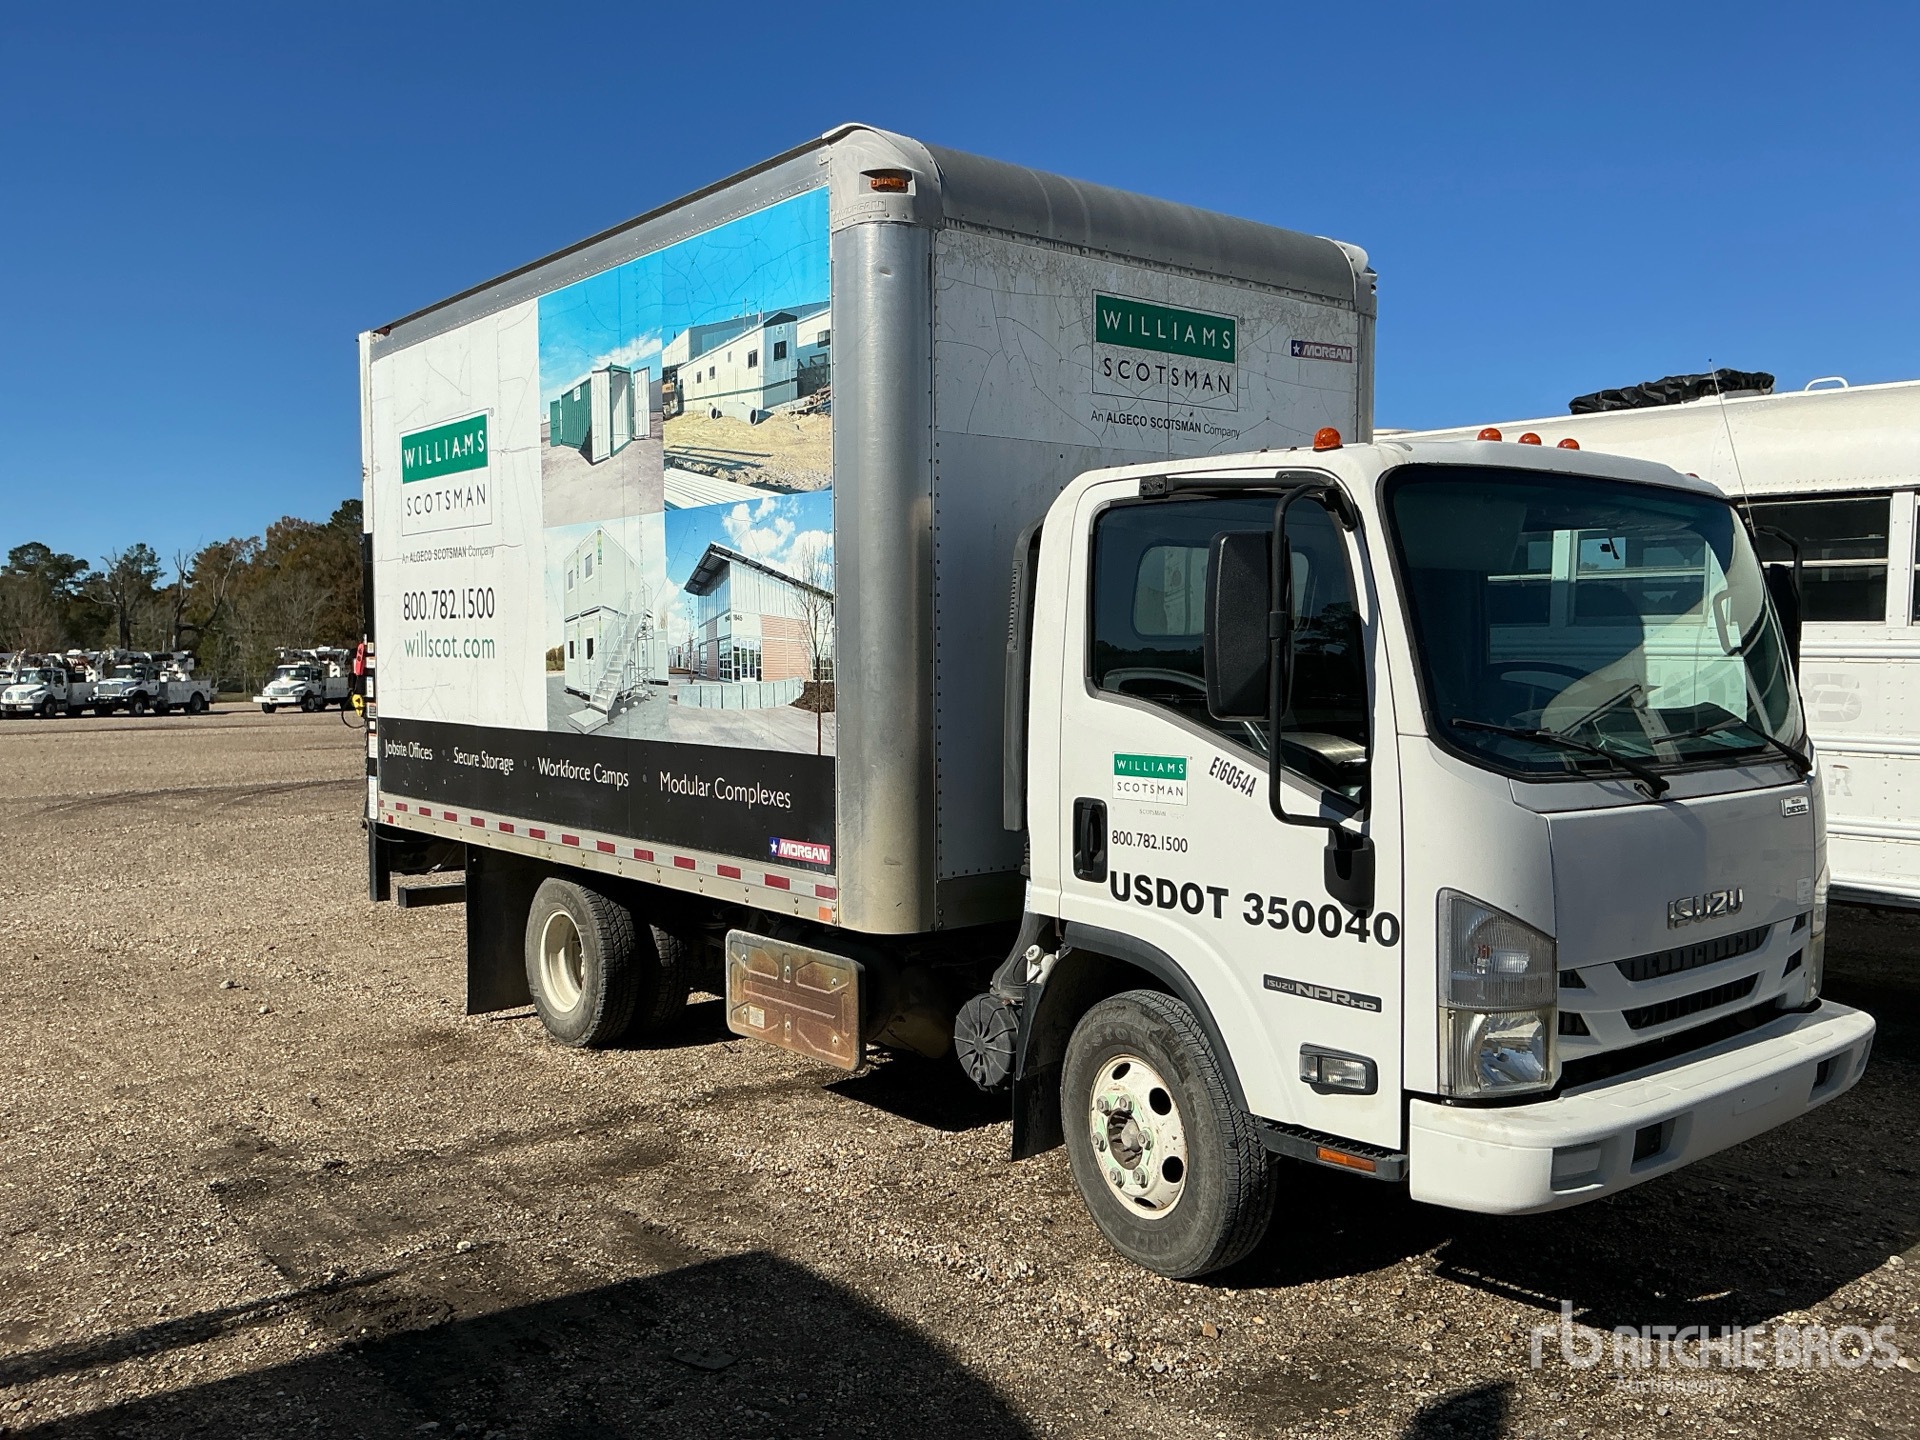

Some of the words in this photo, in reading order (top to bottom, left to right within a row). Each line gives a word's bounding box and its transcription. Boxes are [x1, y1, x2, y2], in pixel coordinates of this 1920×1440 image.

[1102, 309, 1231, 350] WILLIAMS
[1302, 344, 1351, 361] MORGAN
[1103, 357, 1231, 394] SCOTSMAN
[1091, 410, 1104, 423] An
[1106, 412, 1148, 427] ALGECO
[1150, 415, 1201, 433] SCOTSMAN
[1203, 423, 1240, 441] Company
[404, 429, 485, 469] WILLIAMS
[406, 483, 487, 517] SCOTSMAN
[434, 546, 467, 560] SCOTSMAN
[403, 587, 495, 621] 800.782.1500
[404, 630, 496, 660] willscot.com
[384, 739, 408, 758] Jobsite
[408, 741, 433, 760] Offices
[453, 746, 480, 767] Secure
[481, 750, 514, 776] Storage
[537, 756, 591, 782] Workforce
[593, 763, 630, 791] Camps
[1116, 759, 1184, 774] WILLIAMS
[1208, 756, 1257, 798] E16054A
[659, 770, 712, 798] Modular
[714, 777, 792, 810] Complexes
[1116, 781, 1184, 797] SCOTSMAN
[1786, 804, 1808, 815] DIESEL
[779, 841, 828, 862] MORGAN
[1112, 830, 1188, 853] 800.782.1500
[1109, 869, 1229, 920] USDOT
[1242, 891, 1401, 948] 350040
[1667, 886, 1745, 931] ISUZU
[1266, 978, 1295, 991] ISUZU
